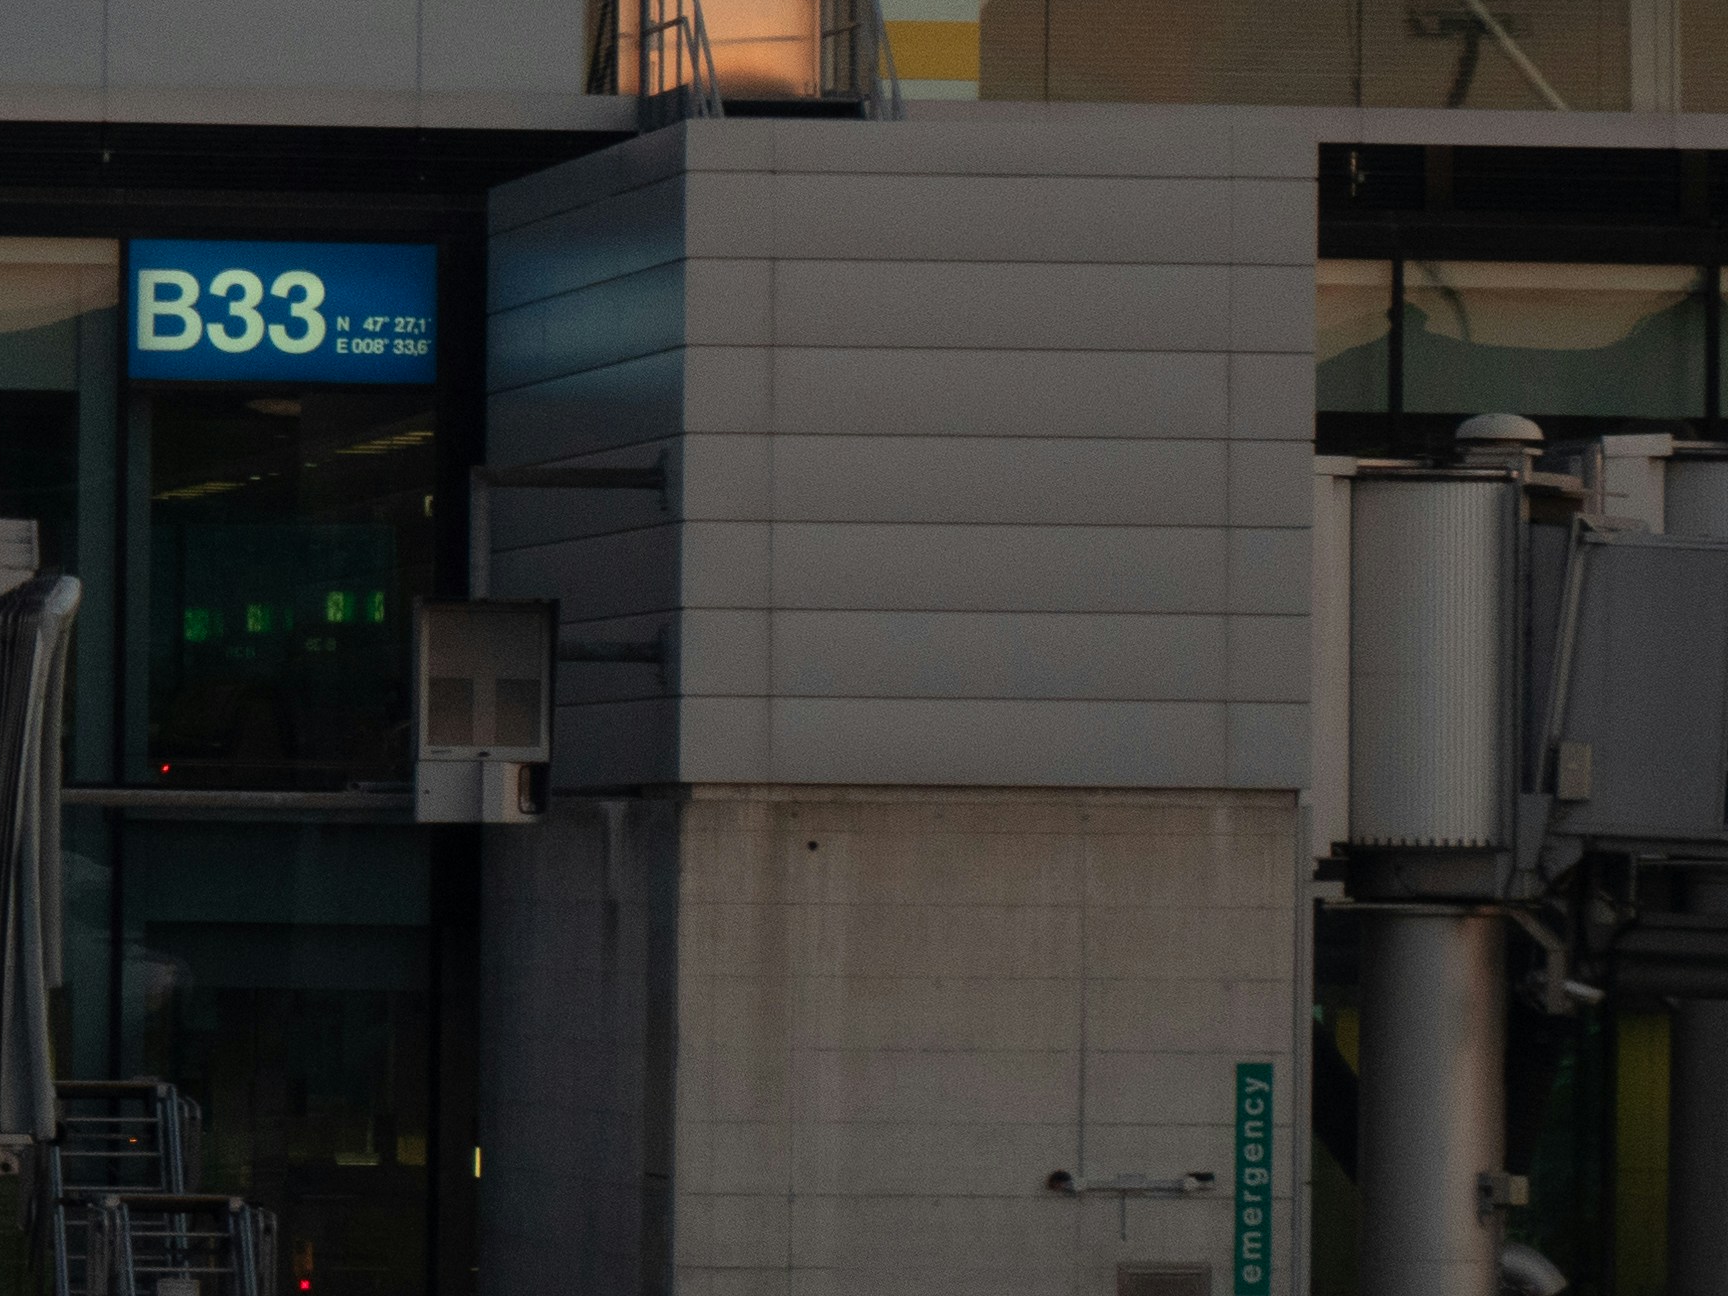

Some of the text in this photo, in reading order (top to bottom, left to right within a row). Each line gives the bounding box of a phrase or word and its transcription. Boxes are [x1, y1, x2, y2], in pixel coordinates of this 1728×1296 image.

[136, 268, 327, 354] B33
[336, 316, 350, 332] N
[336, 338, 349, 354] E
[1242, 1076, 1270, 1285] emergency
